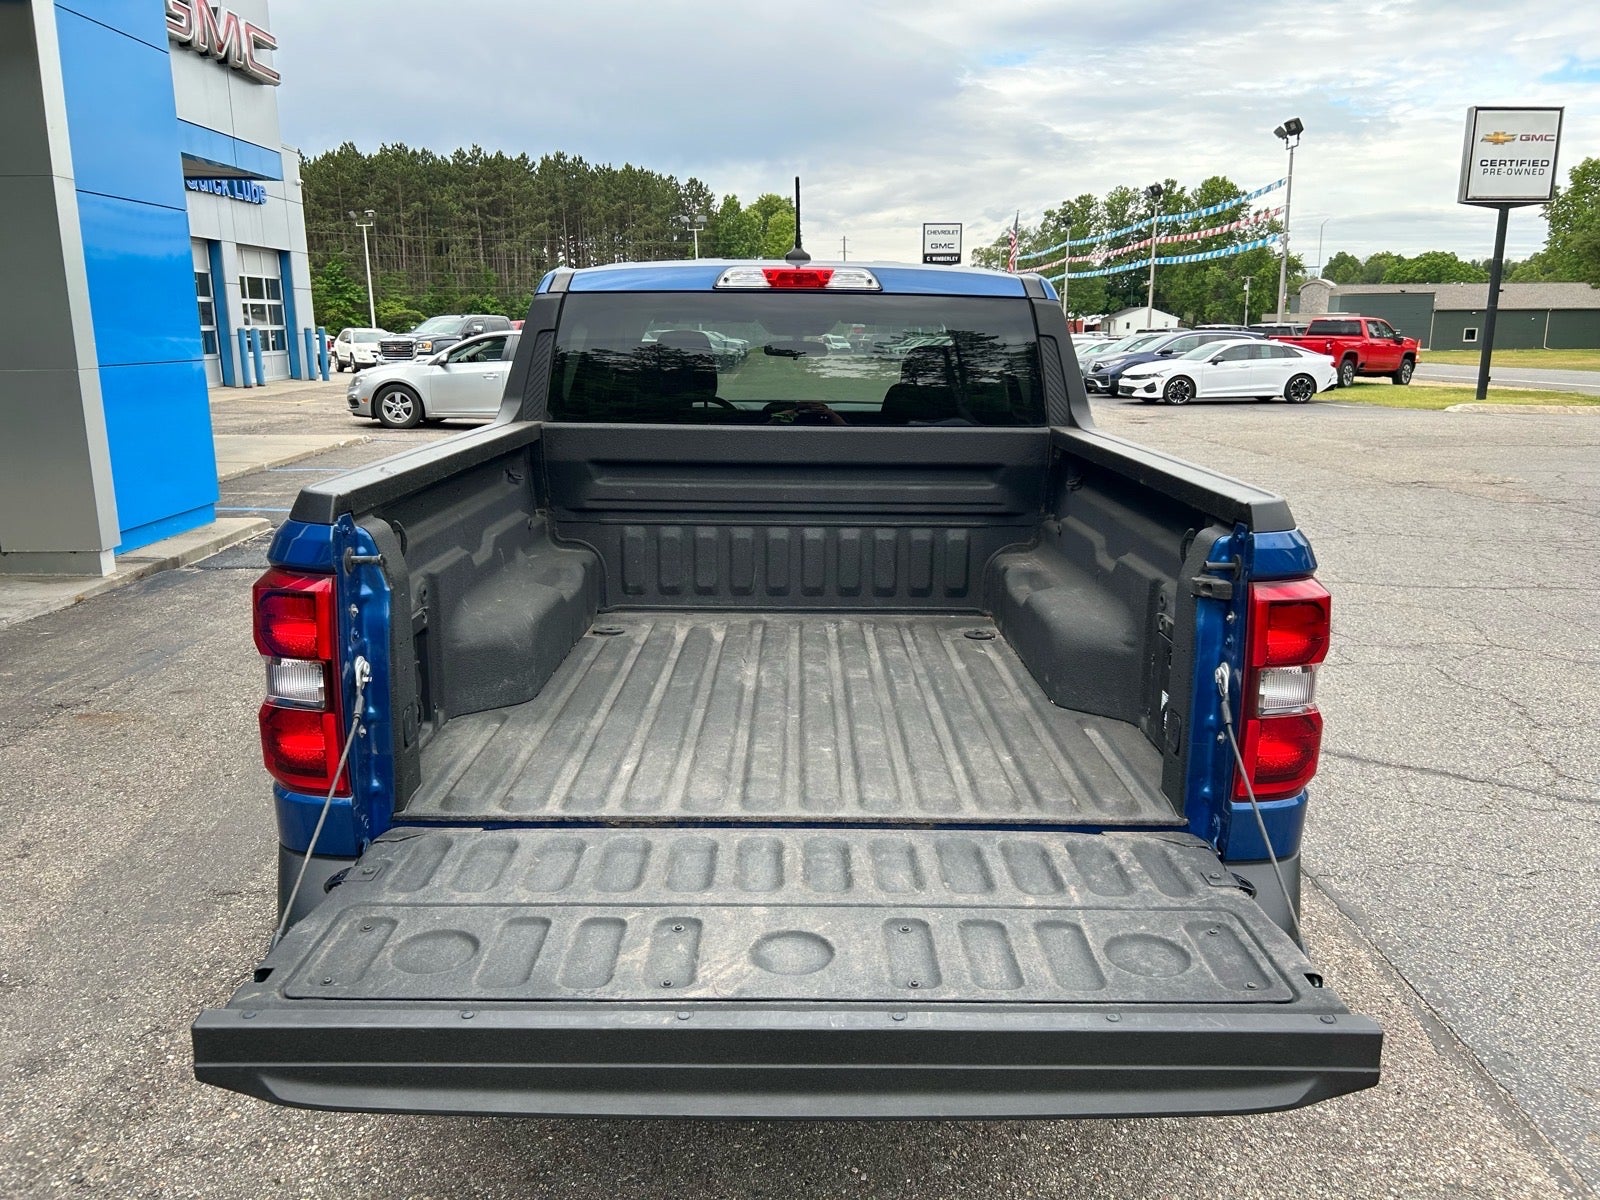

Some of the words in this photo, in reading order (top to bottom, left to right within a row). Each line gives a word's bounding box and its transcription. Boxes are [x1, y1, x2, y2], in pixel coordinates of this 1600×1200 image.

[1519, 134, 1556, 142] GMC
[1479, 159, 1550, 167] CERTIFIED
[1482, 168, 1545, 176] PRE-OWNED
[234, 180, 267, 205] Lube
